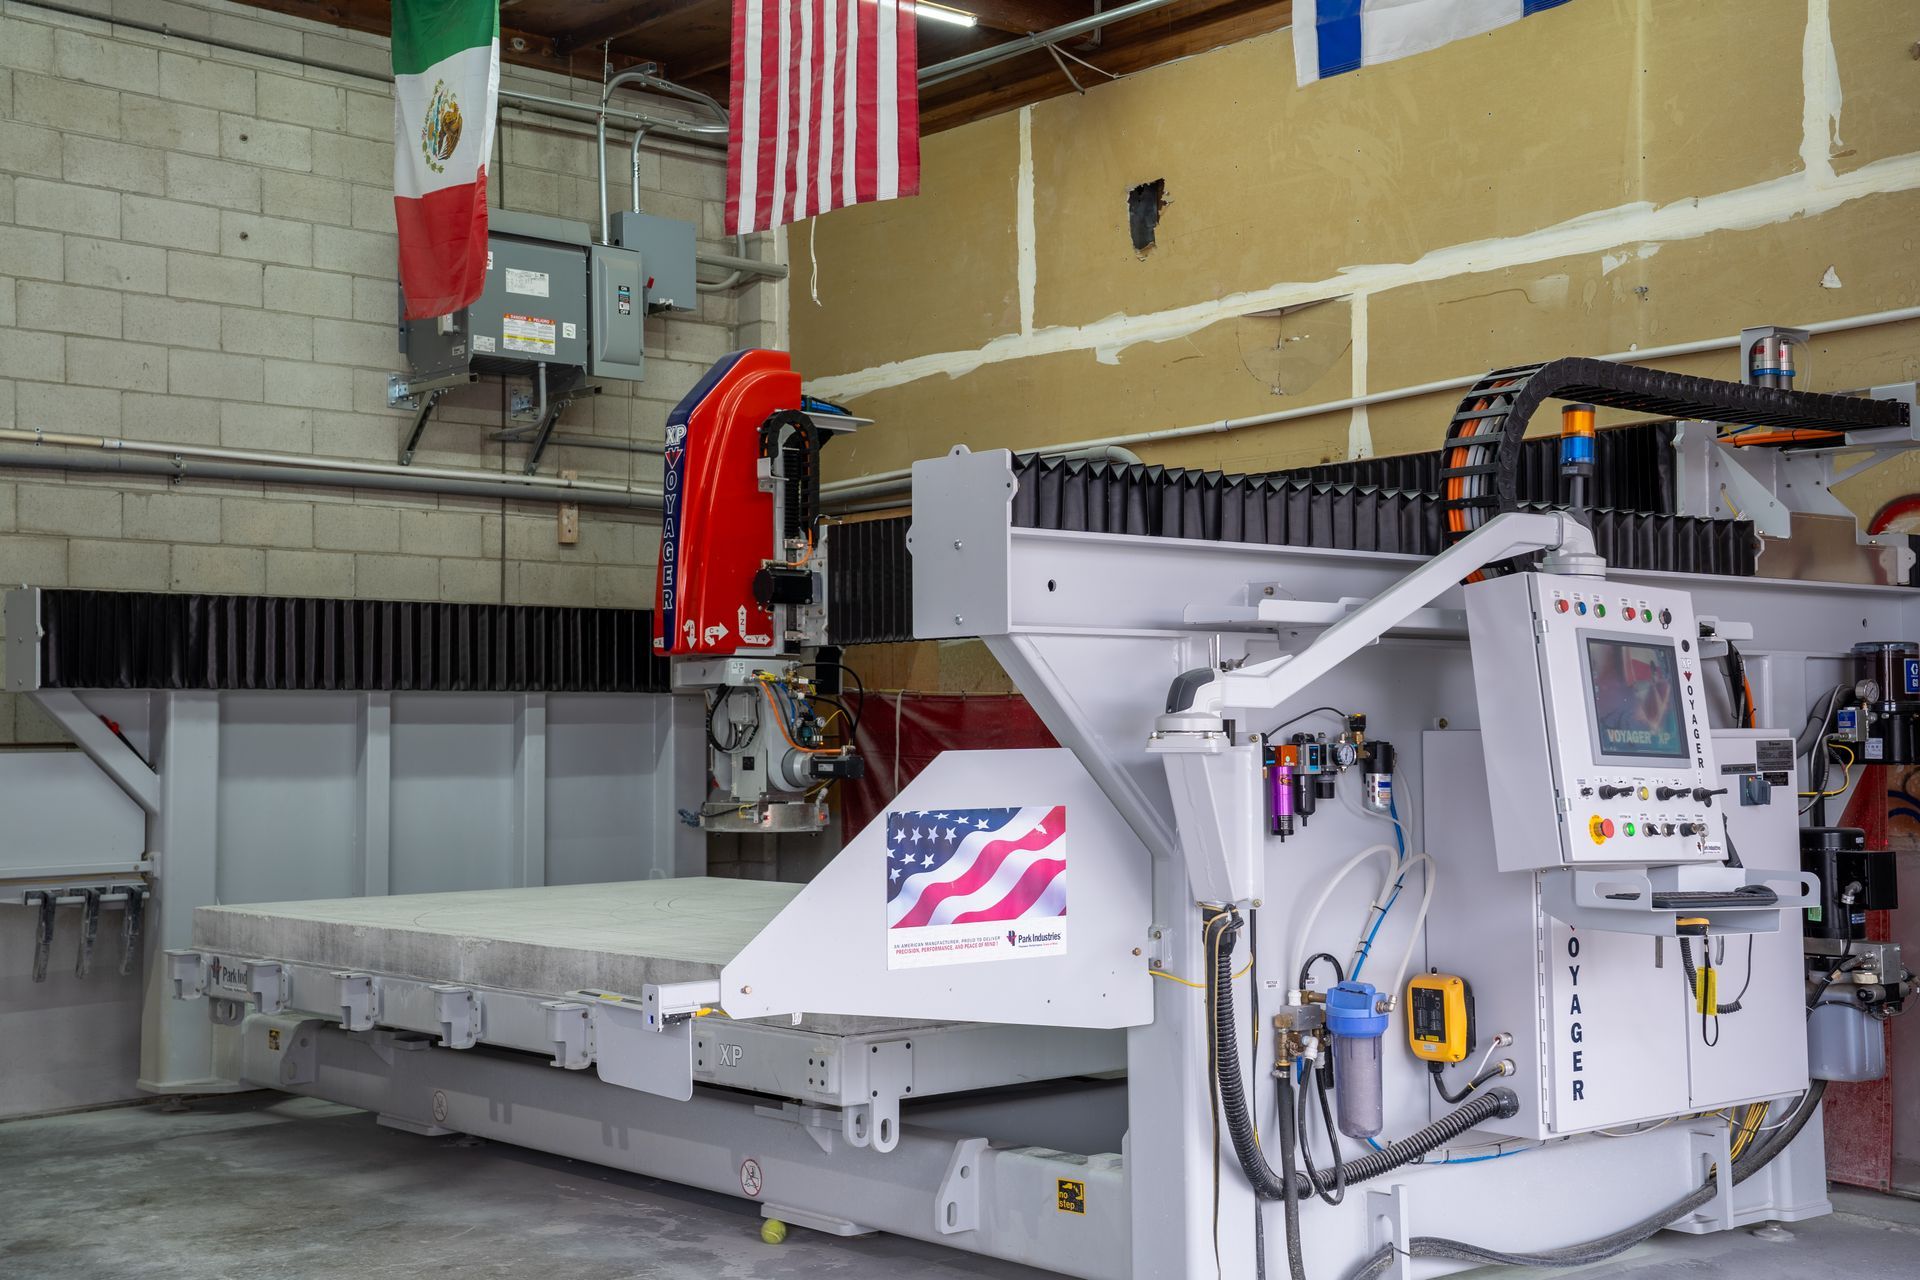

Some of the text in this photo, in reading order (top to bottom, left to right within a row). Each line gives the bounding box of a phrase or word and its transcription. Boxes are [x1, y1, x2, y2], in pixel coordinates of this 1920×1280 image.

[665, 424, 687, 447] XP
[662, 446, 684, 610] VOYAGER
[1606, 728, 1652, 744] VOYAGER
[1018, 931, 1062, 943] Park Industries
[222, 966, 237, 983] Park
[1567, 925, 1585, 1101] OYAGER
[718, 1042, 744, 1068] XP
[1058, 1191, 1068, 1199] no
[1058, 1199, 1075, 1210] step
